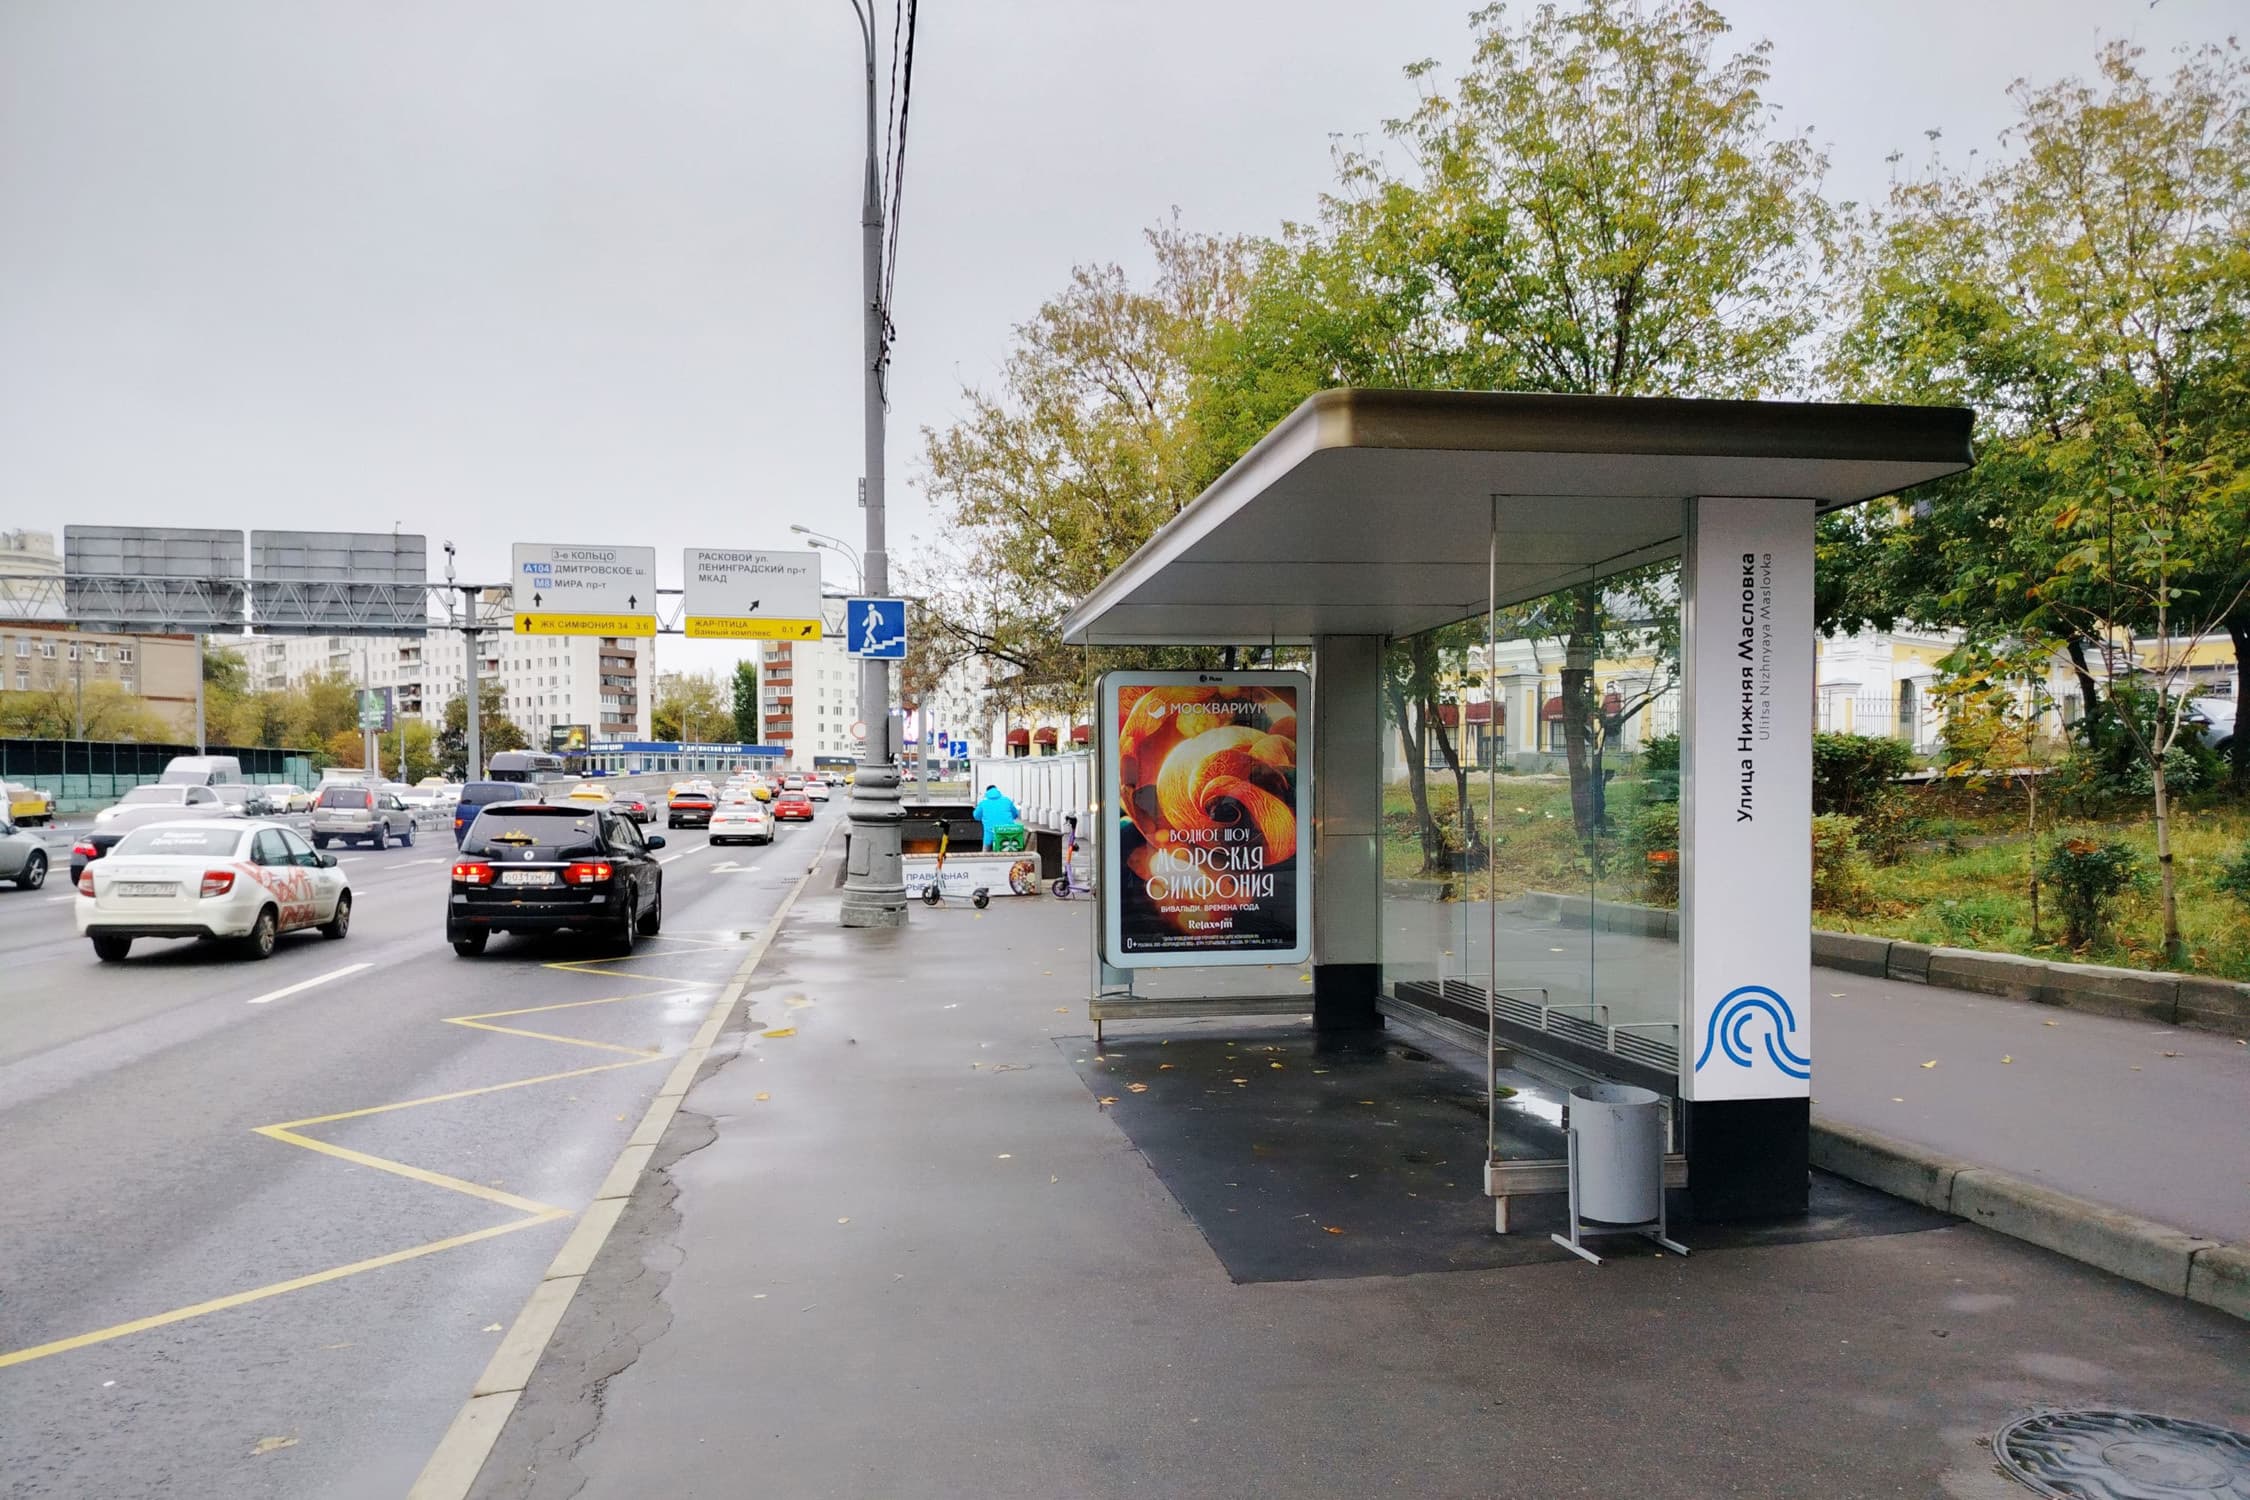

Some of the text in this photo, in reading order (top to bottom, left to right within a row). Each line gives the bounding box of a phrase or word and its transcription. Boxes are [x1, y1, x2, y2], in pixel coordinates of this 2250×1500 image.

[553, 550, 615, 562] 3-е КОЛЬЦО
[698, 552, 769, 564] РАСКОВОЙ ул.
[554, 564, 646, 576] ДМИТРОВСКОЕ ш.
[698, 562, 807, 575] ЛЕНИНГРАДСКИЙ пр-т
[554, 579, 607, 591] МИРА пр-т
[698, 574, 728, 584] МКАД
[540, 620, 555, 629] ЖК
[557, 619, 615, 630] СИМФОНИЯ
[694, 619, 748, 629] ЖАР-ПТИЦА
[731, 630, 772, 638] комплекс
[1759, 553, 1773, 741] Ulitsa Nizhnyaya Maslovka
[1736, 553, 1755, 823] Улица Нижняя Масловка
[1170, 702, 1268, 715] МОСКВАРИУМ
[678, 744, 722, 753] МДИИНСКИЙ
[1169, 827, 1250, 844] ВОДНОЕ ШОУ
[1156, 846, 1263, 872] МОРСКАЯ
[1146, 873, 1274, 900] СИМФОНИЯ
[1203, 904, 1238, 912] ВРЕМЕНА
[1239, 903, 1260, 911] ГОДА
